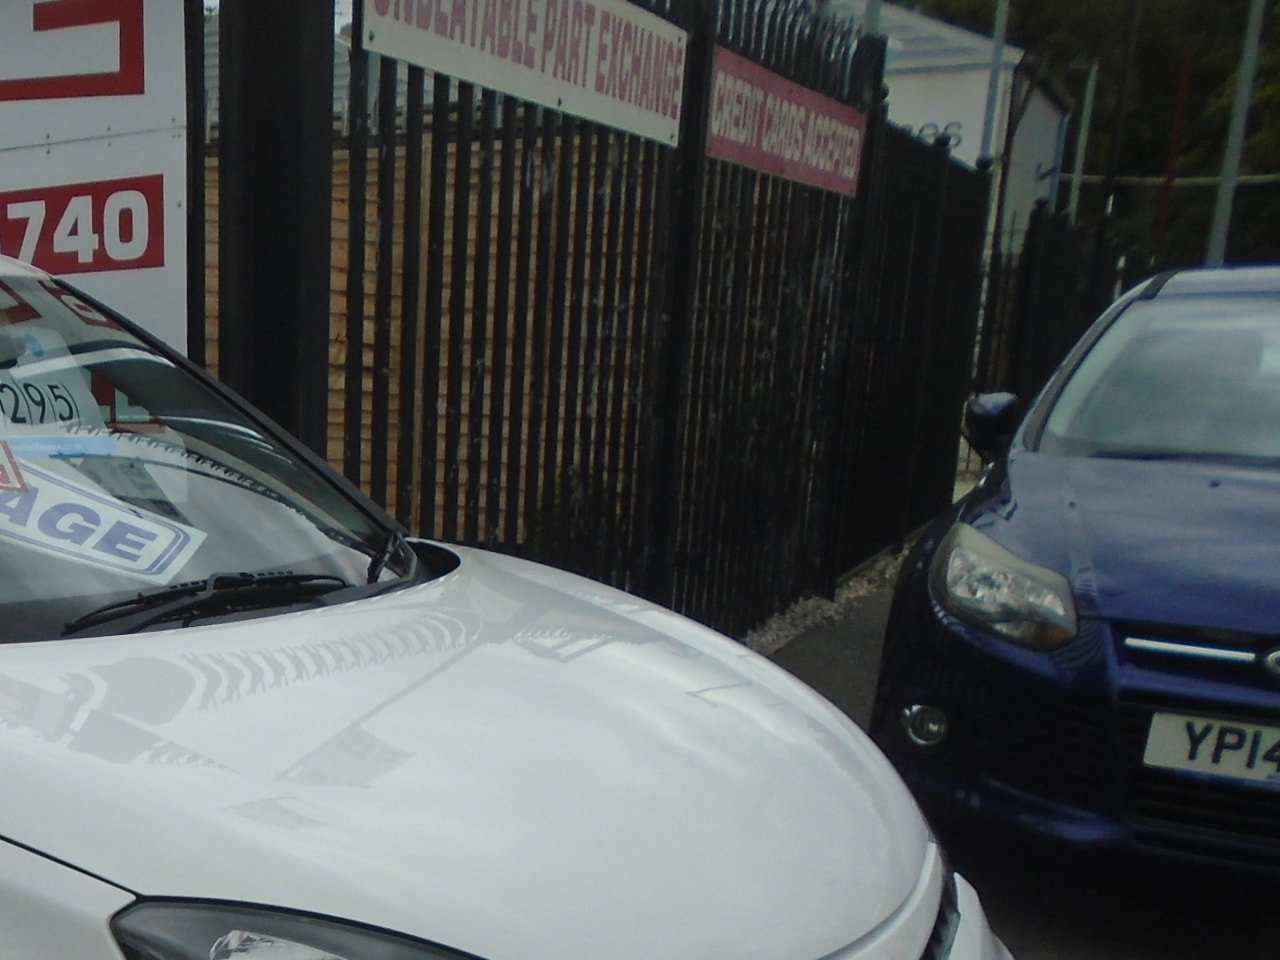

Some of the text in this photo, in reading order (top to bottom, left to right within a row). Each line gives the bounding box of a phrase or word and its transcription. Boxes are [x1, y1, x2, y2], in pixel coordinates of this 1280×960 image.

[374, 0, 684, 120] ATABLE PART EXCHANGE
[711, 70, 860, 179] CREDIT CARDS ACCEPTED
